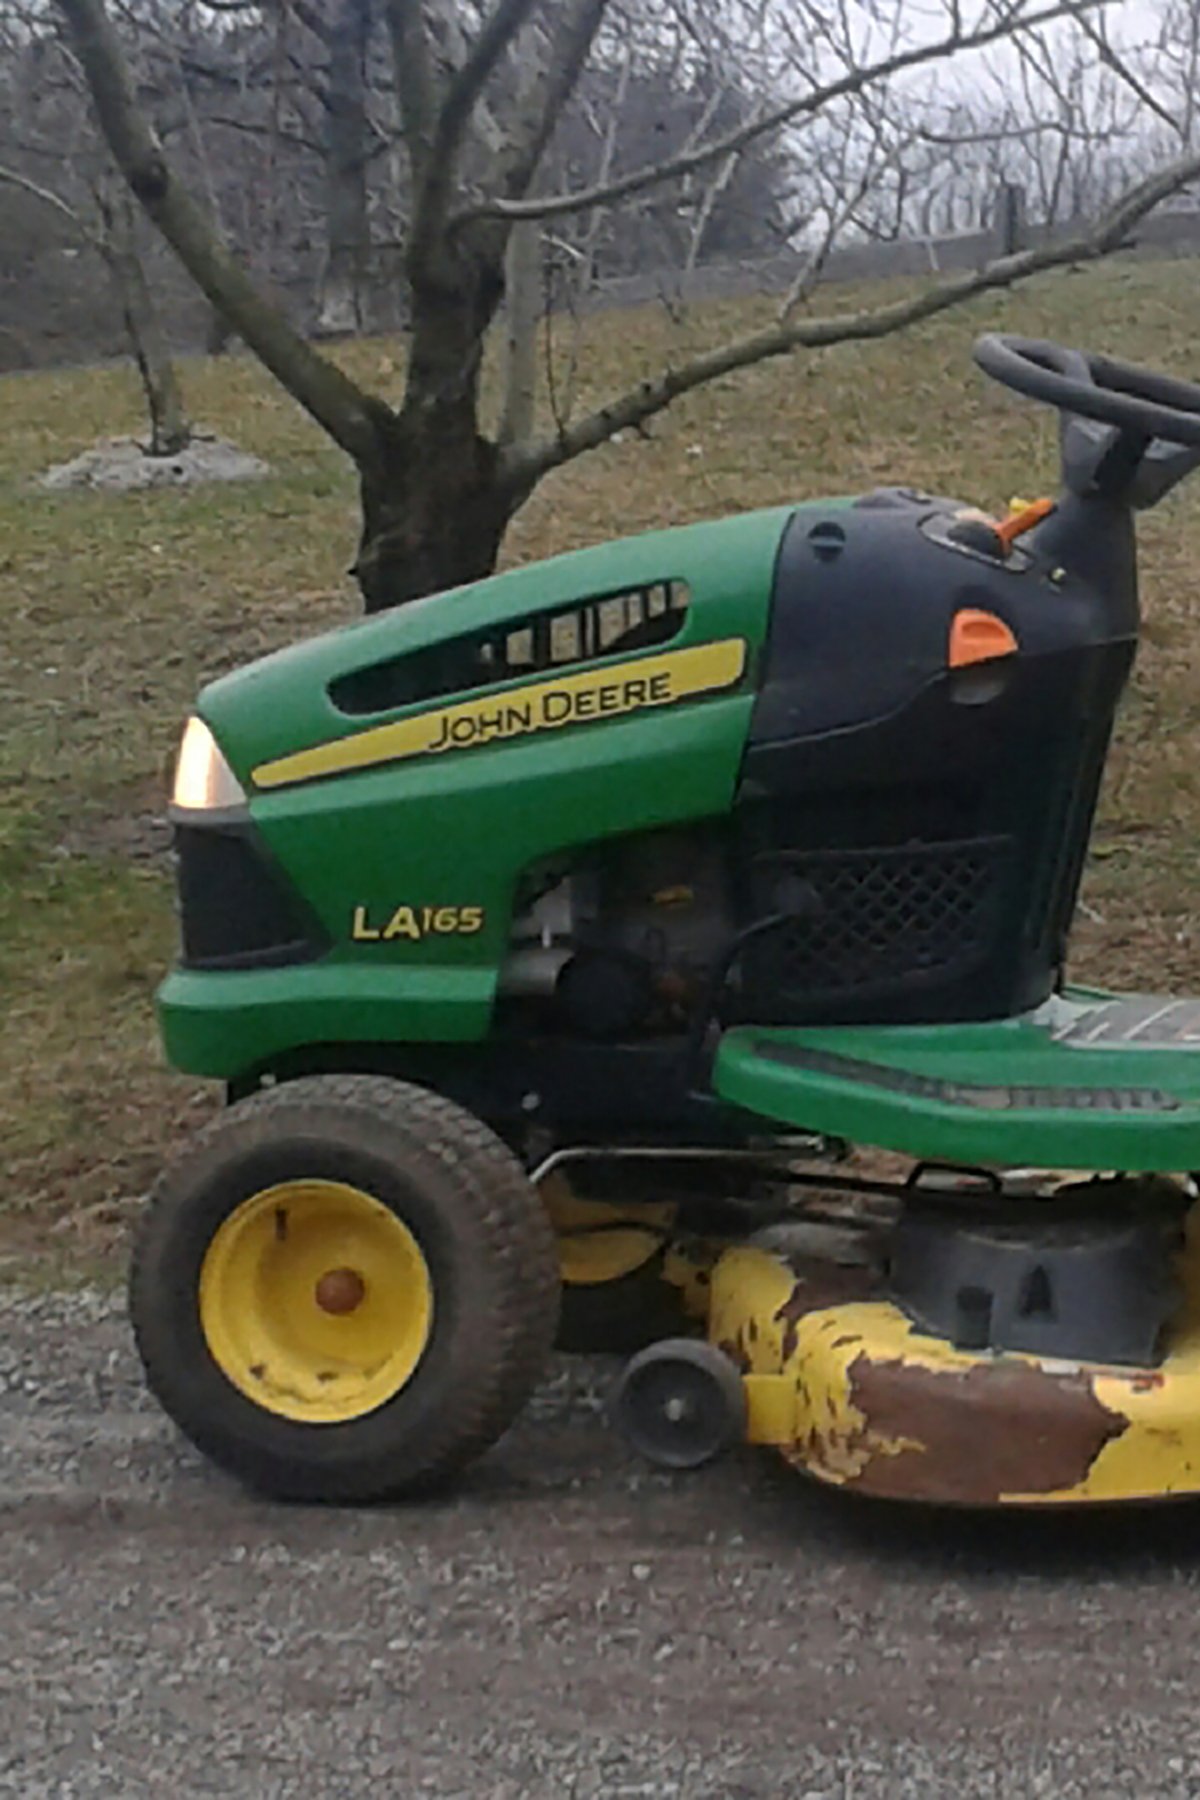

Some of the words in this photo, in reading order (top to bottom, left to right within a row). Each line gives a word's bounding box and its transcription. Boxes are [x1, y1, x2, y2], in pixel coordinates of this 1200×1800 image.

[430, 702, 532, 749] JOHN
[542, 673, 672, 723] DEERE
[352, 905, 483, 940] LA165
